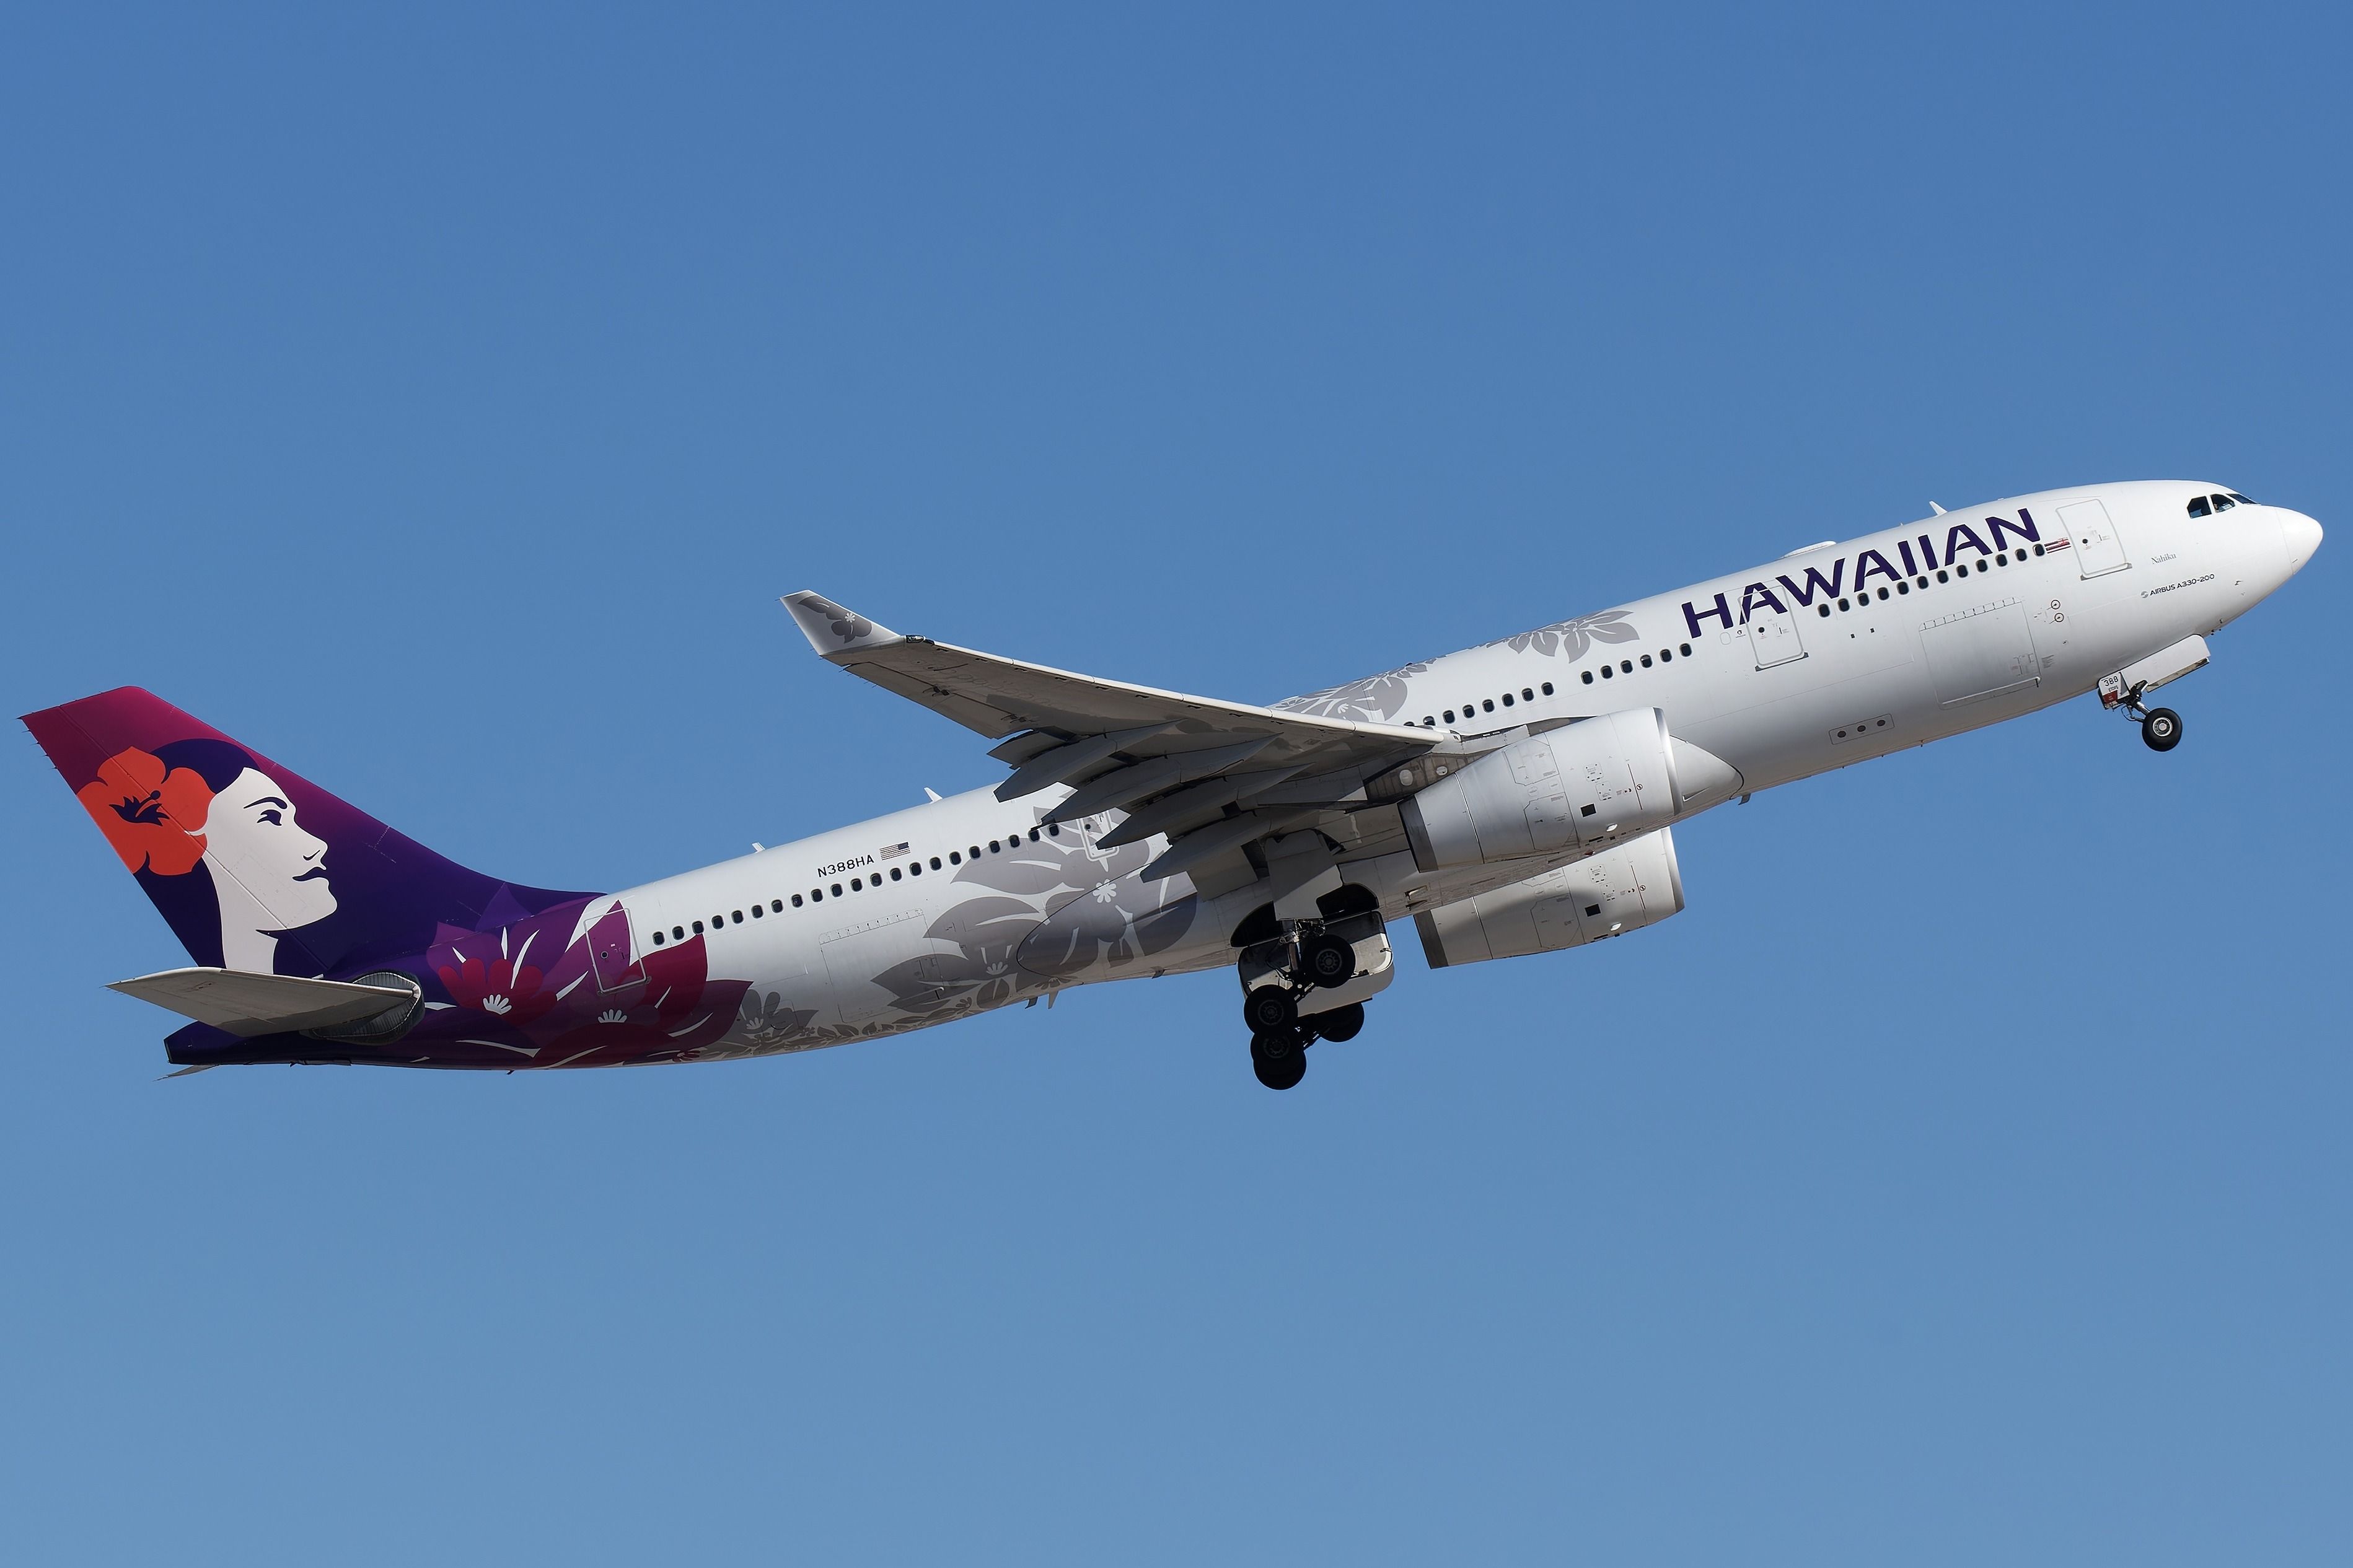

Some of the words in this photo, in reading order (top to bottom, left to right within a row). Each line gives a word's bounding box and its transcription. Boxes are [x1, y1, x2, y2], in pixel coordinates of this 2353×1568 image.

[2151, 553, 2176, 564] Nahiku
[1681, 508, 2041, 639] HAWAIIAN
[2150, 584, 2176, 596] AIRBUS
[2176, 574, 2215, 589] A330-200
[2104, 676, 2118, 686] 388
[817, 854, 874, 878] N388HA
